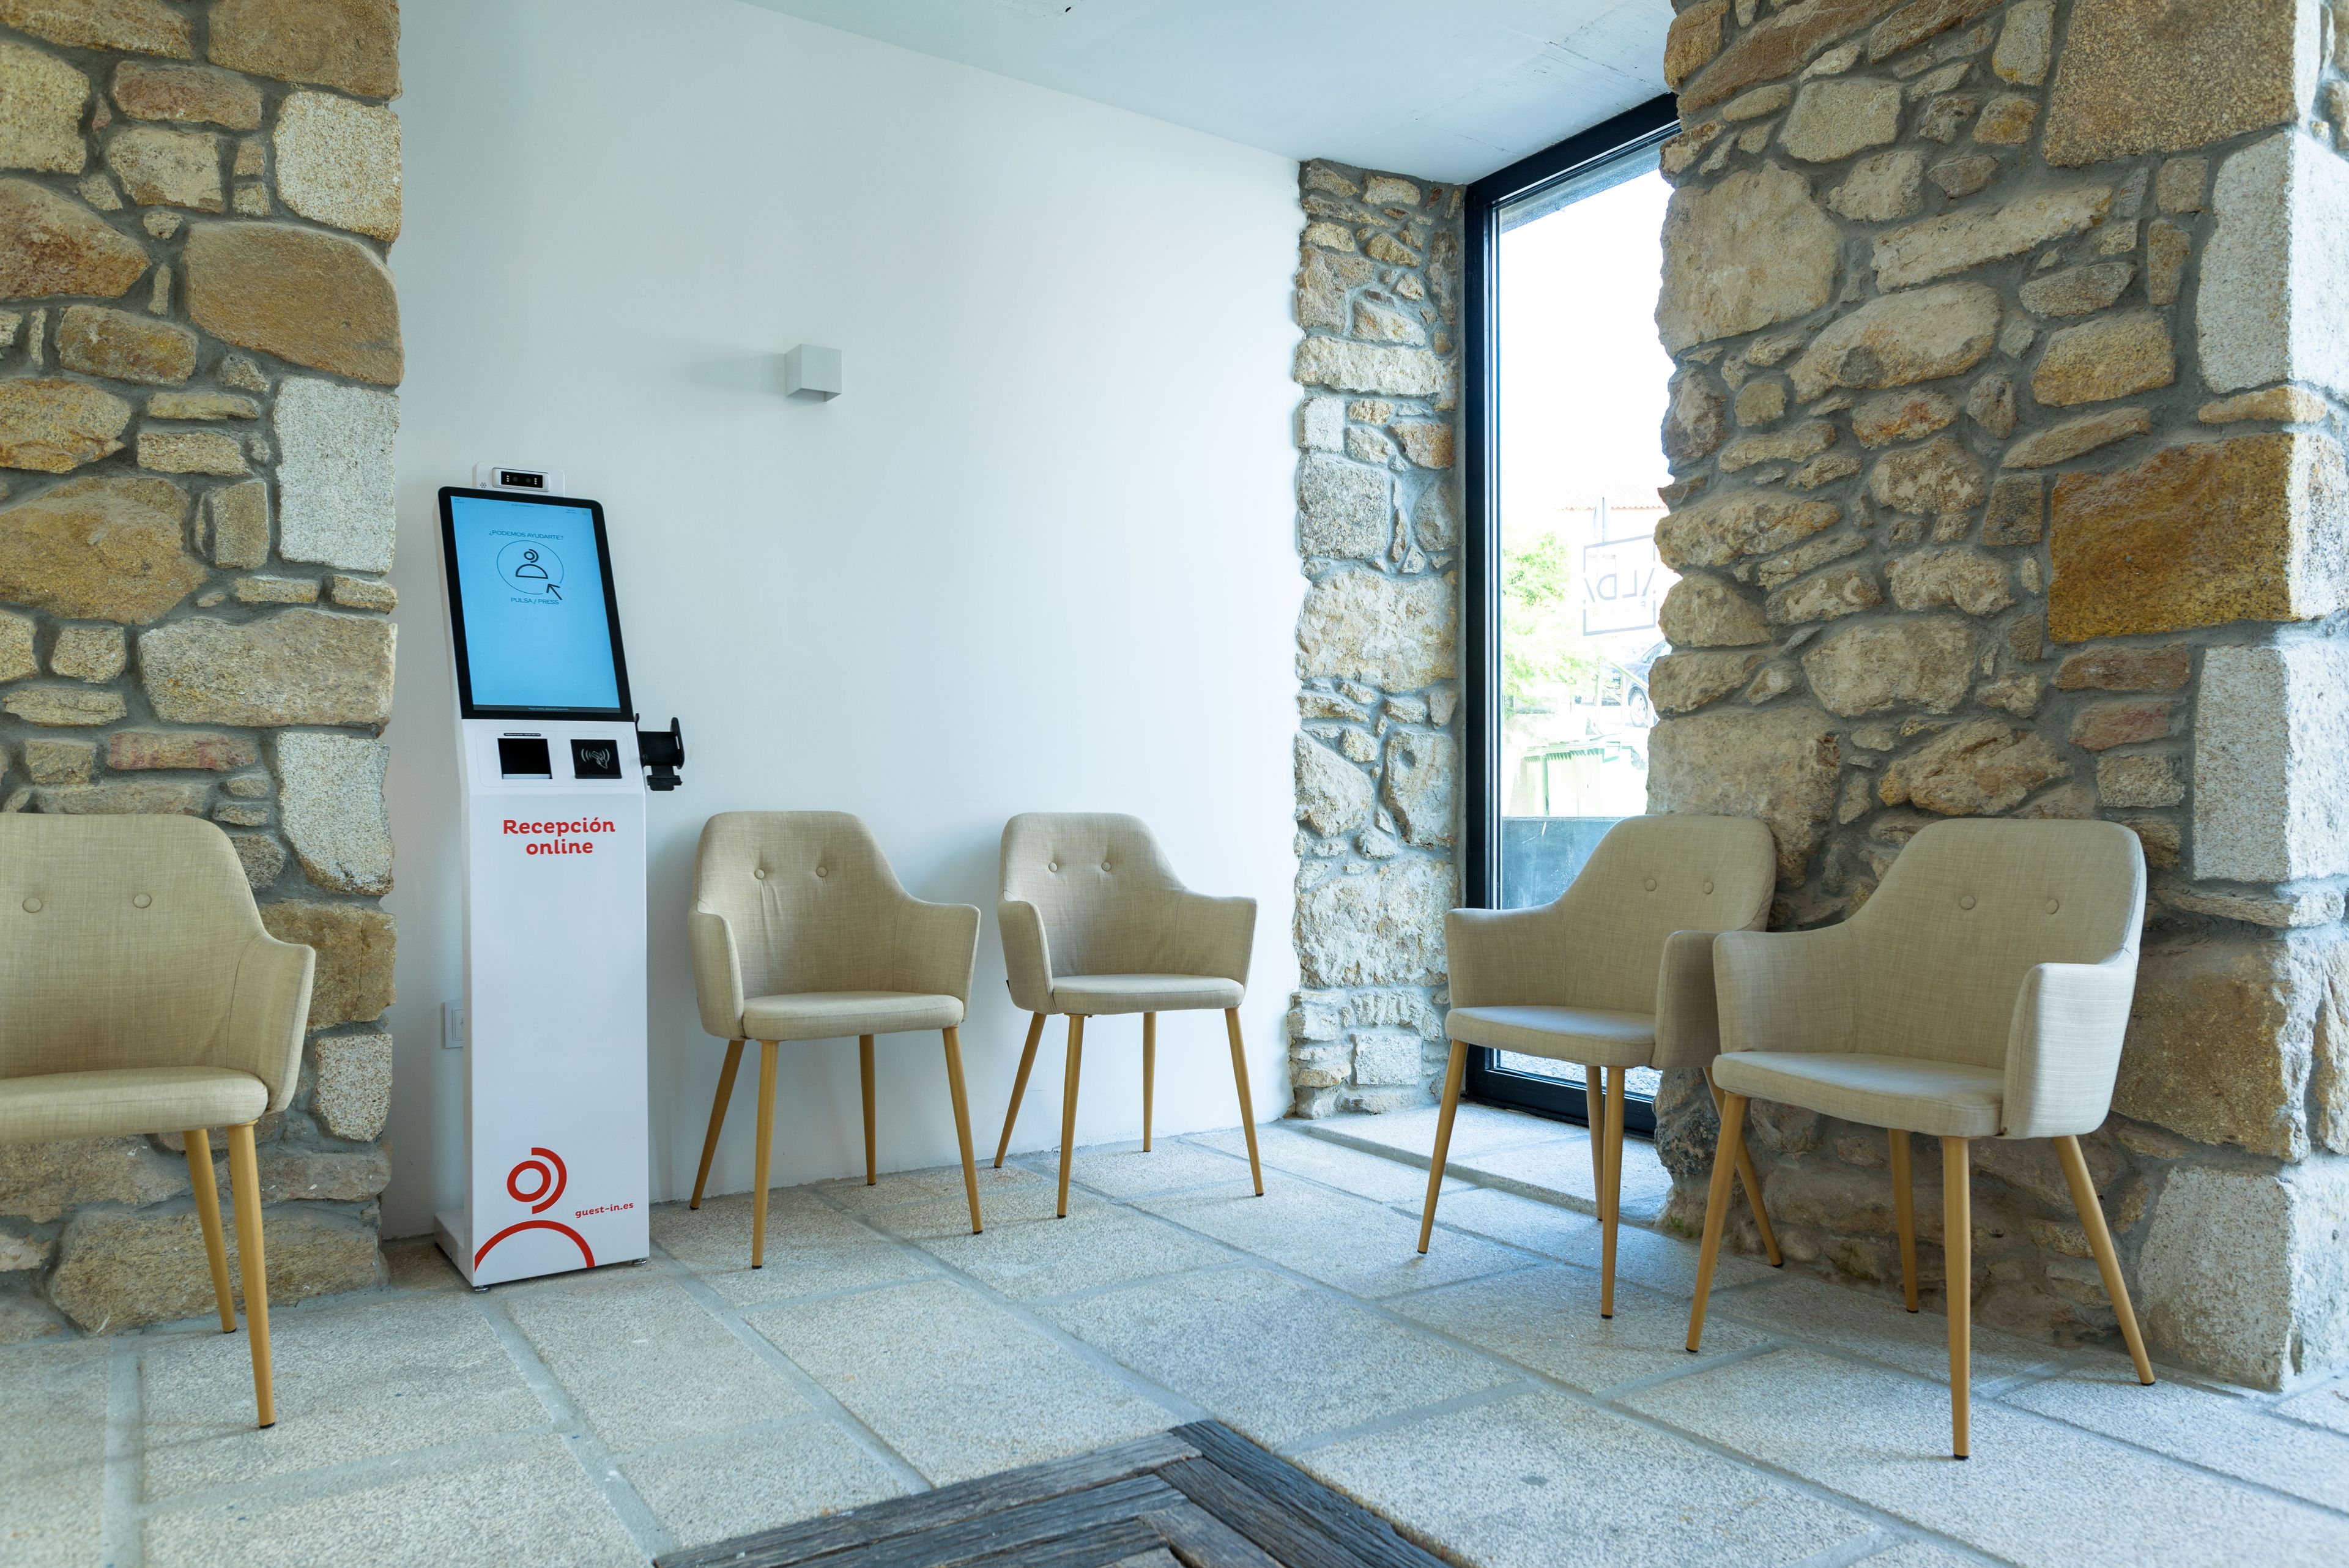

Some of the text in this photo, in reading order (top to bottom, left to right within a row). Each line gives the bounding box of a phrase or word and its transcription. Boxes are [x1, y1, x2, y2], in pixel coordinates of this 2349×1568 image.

[503, 817, 615, 837] Recepción
[526, 839, 593, 855] online
[575, 1203, 634, 1219] guest-in.es
